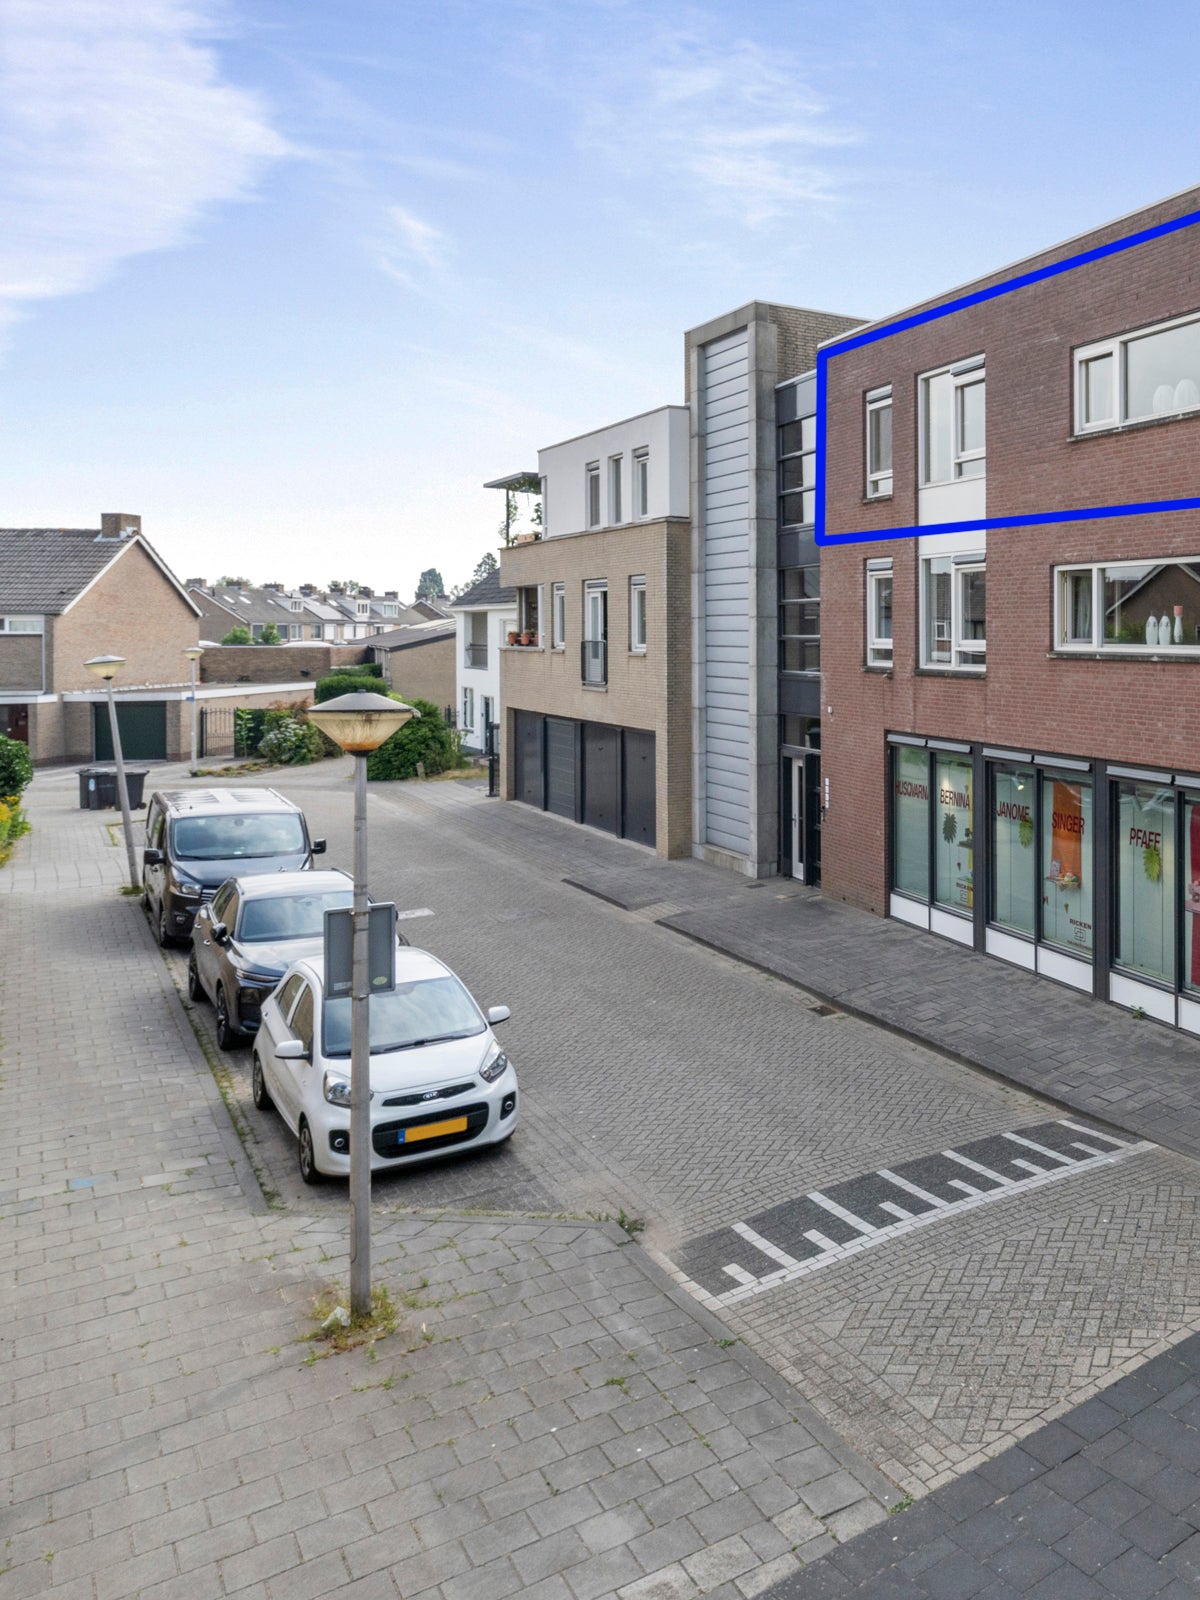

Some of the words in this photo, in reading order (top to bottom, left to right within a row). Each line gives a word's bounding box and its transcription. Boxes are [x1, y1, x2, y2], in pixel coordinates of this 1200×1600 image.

[939, 789, 970, 809] BERNINA
[996, 800, 1030, 823] JANOME
[1052, 811, 1085, 835] SINGER
[1129, 828, 1161, 851] PFAFF
[1069, 918, 1092, 930] RICKEN
